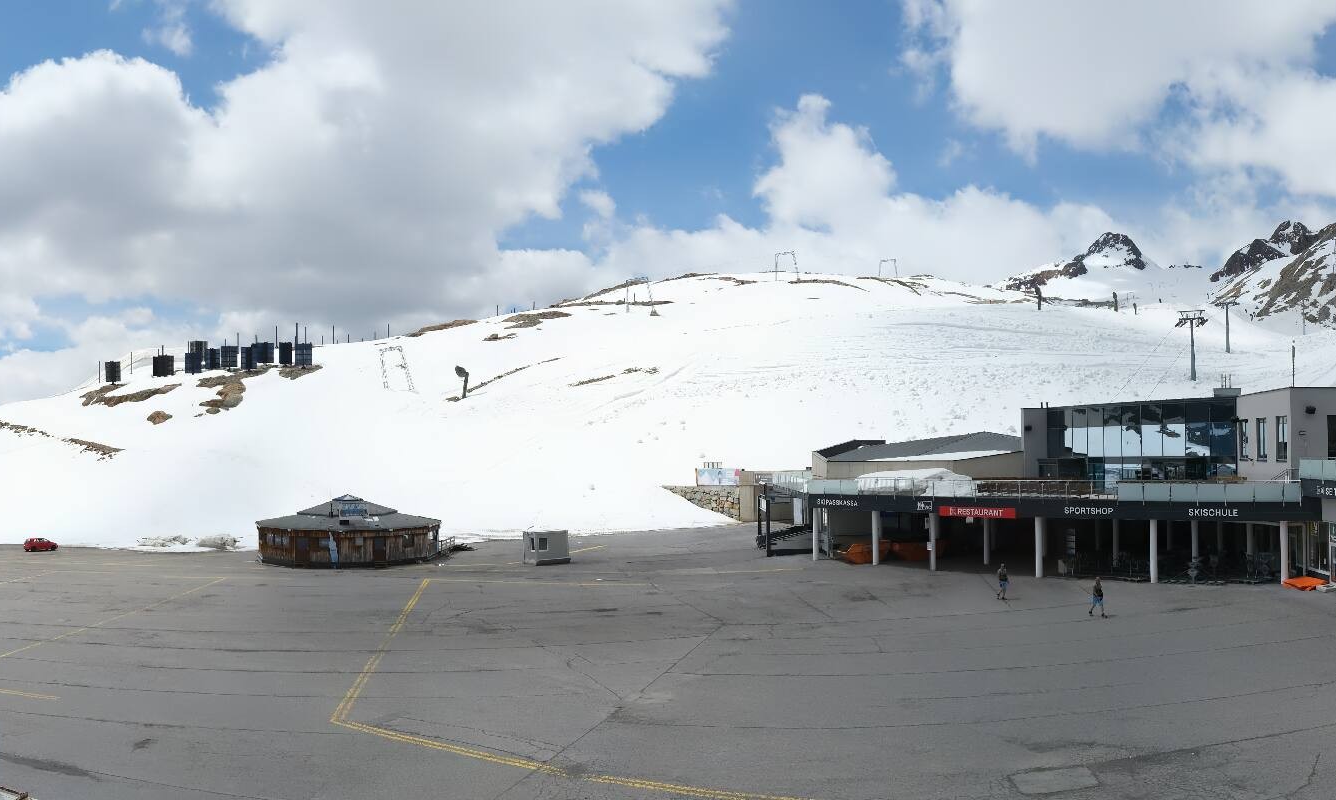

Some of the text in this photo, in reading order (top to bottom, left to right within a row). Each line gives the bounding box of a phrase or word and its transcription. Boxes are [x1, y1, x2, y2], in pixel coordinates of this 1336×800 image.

[817, 498, 858, 507] SKIPASSKASSA
[957, 508, 1004, 517] RESTAURANT
[1064, 506, 1114, 515] SPORTSHOP
[1188, 508, 1239, 517] SKISCHULE
